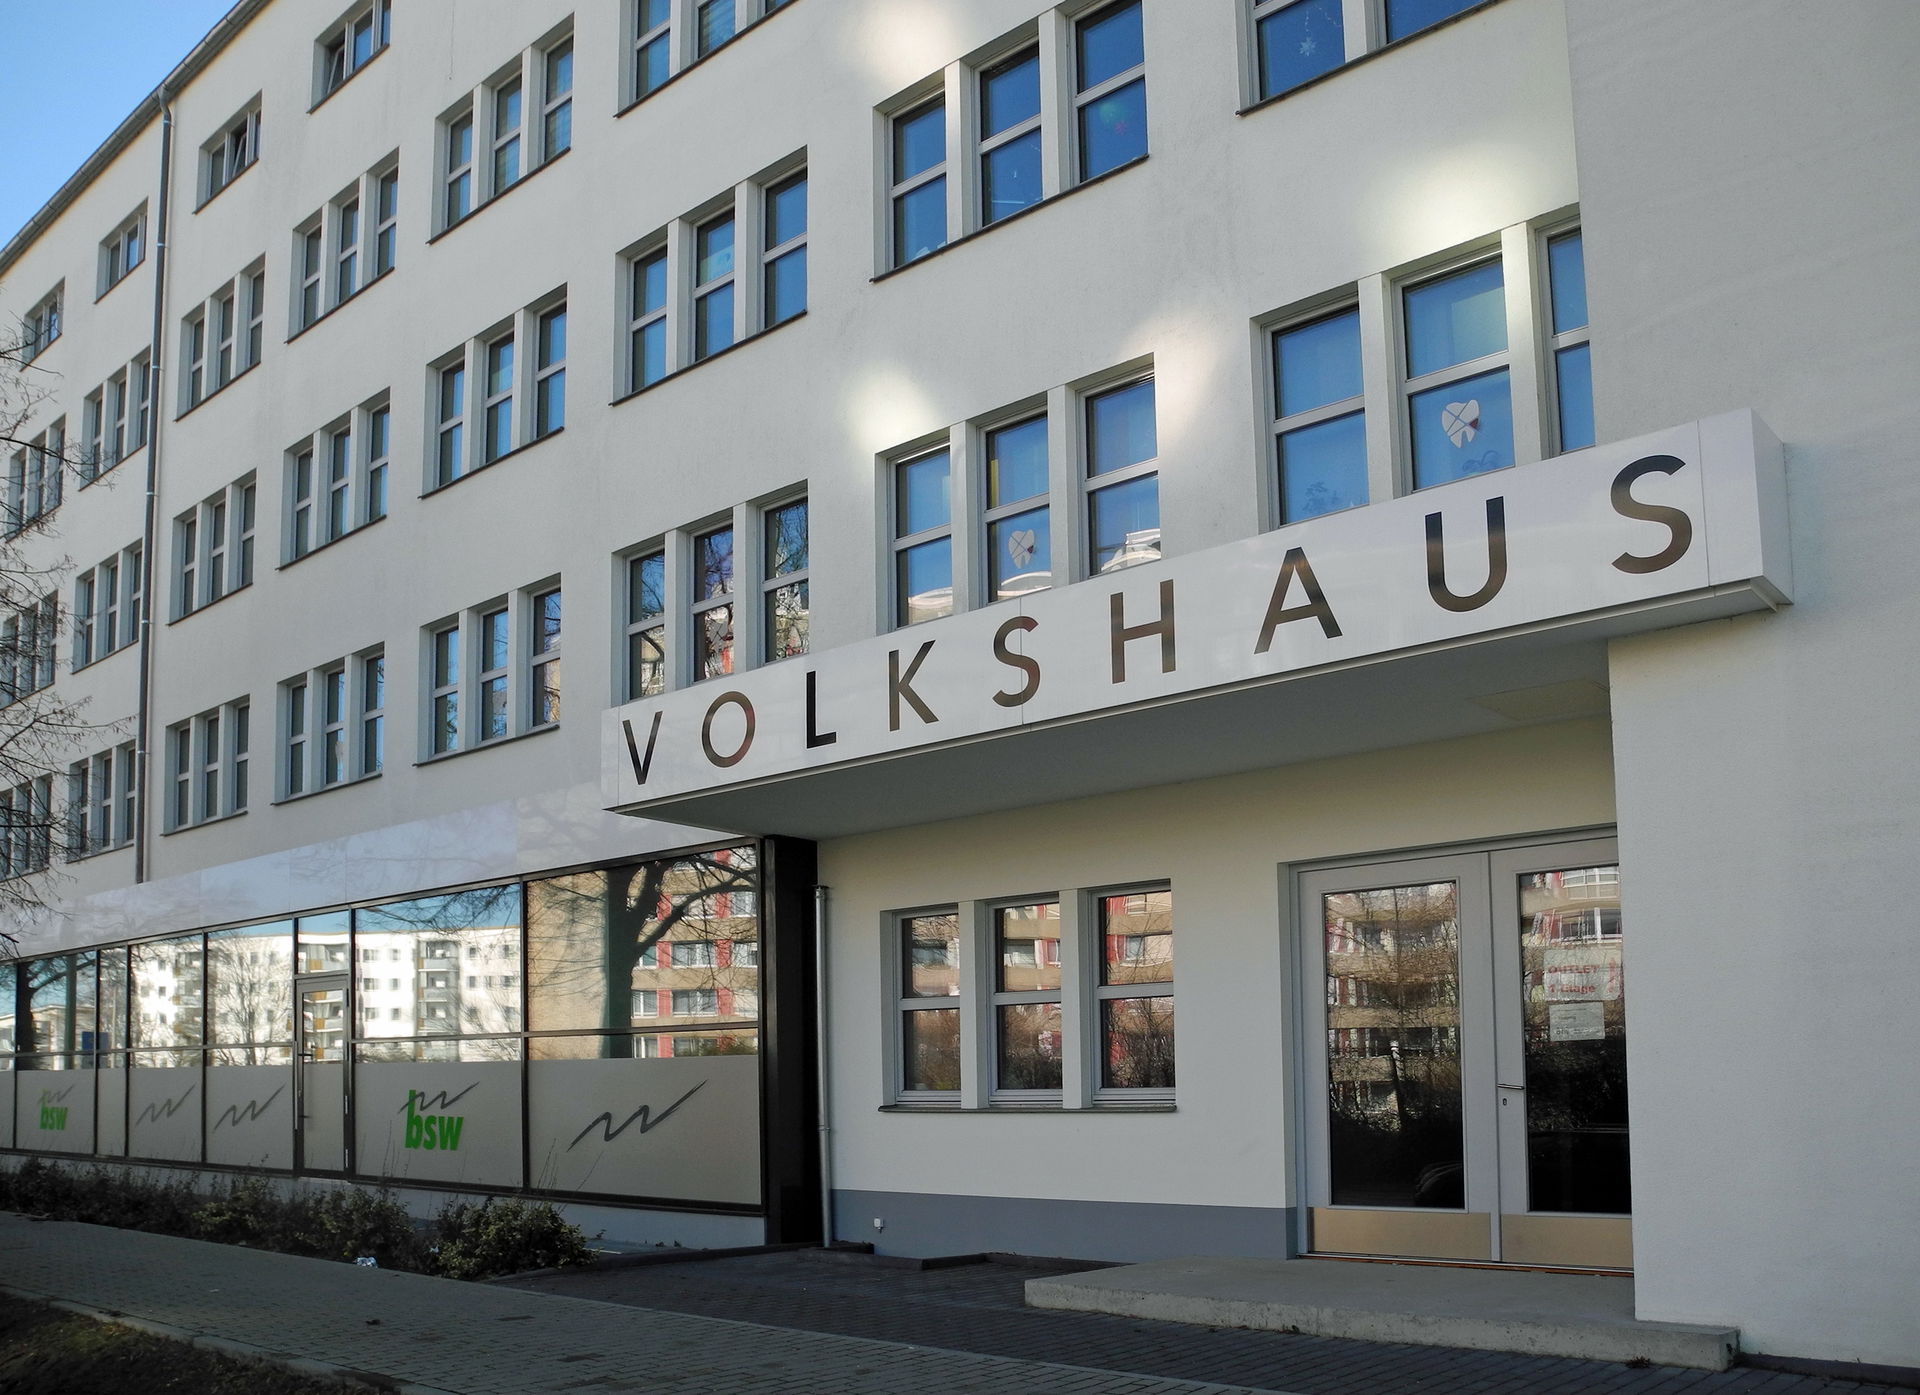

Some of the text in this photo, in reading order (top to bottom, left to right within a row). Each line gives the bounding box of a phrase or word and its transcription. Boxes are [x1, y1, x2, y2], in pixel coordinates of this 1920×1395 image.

[622, 455, 1693, 786] VOLKSHAUS
[40, 1088, 68, 1130] bsw
[405, 1089, 464, 1150] bsw
